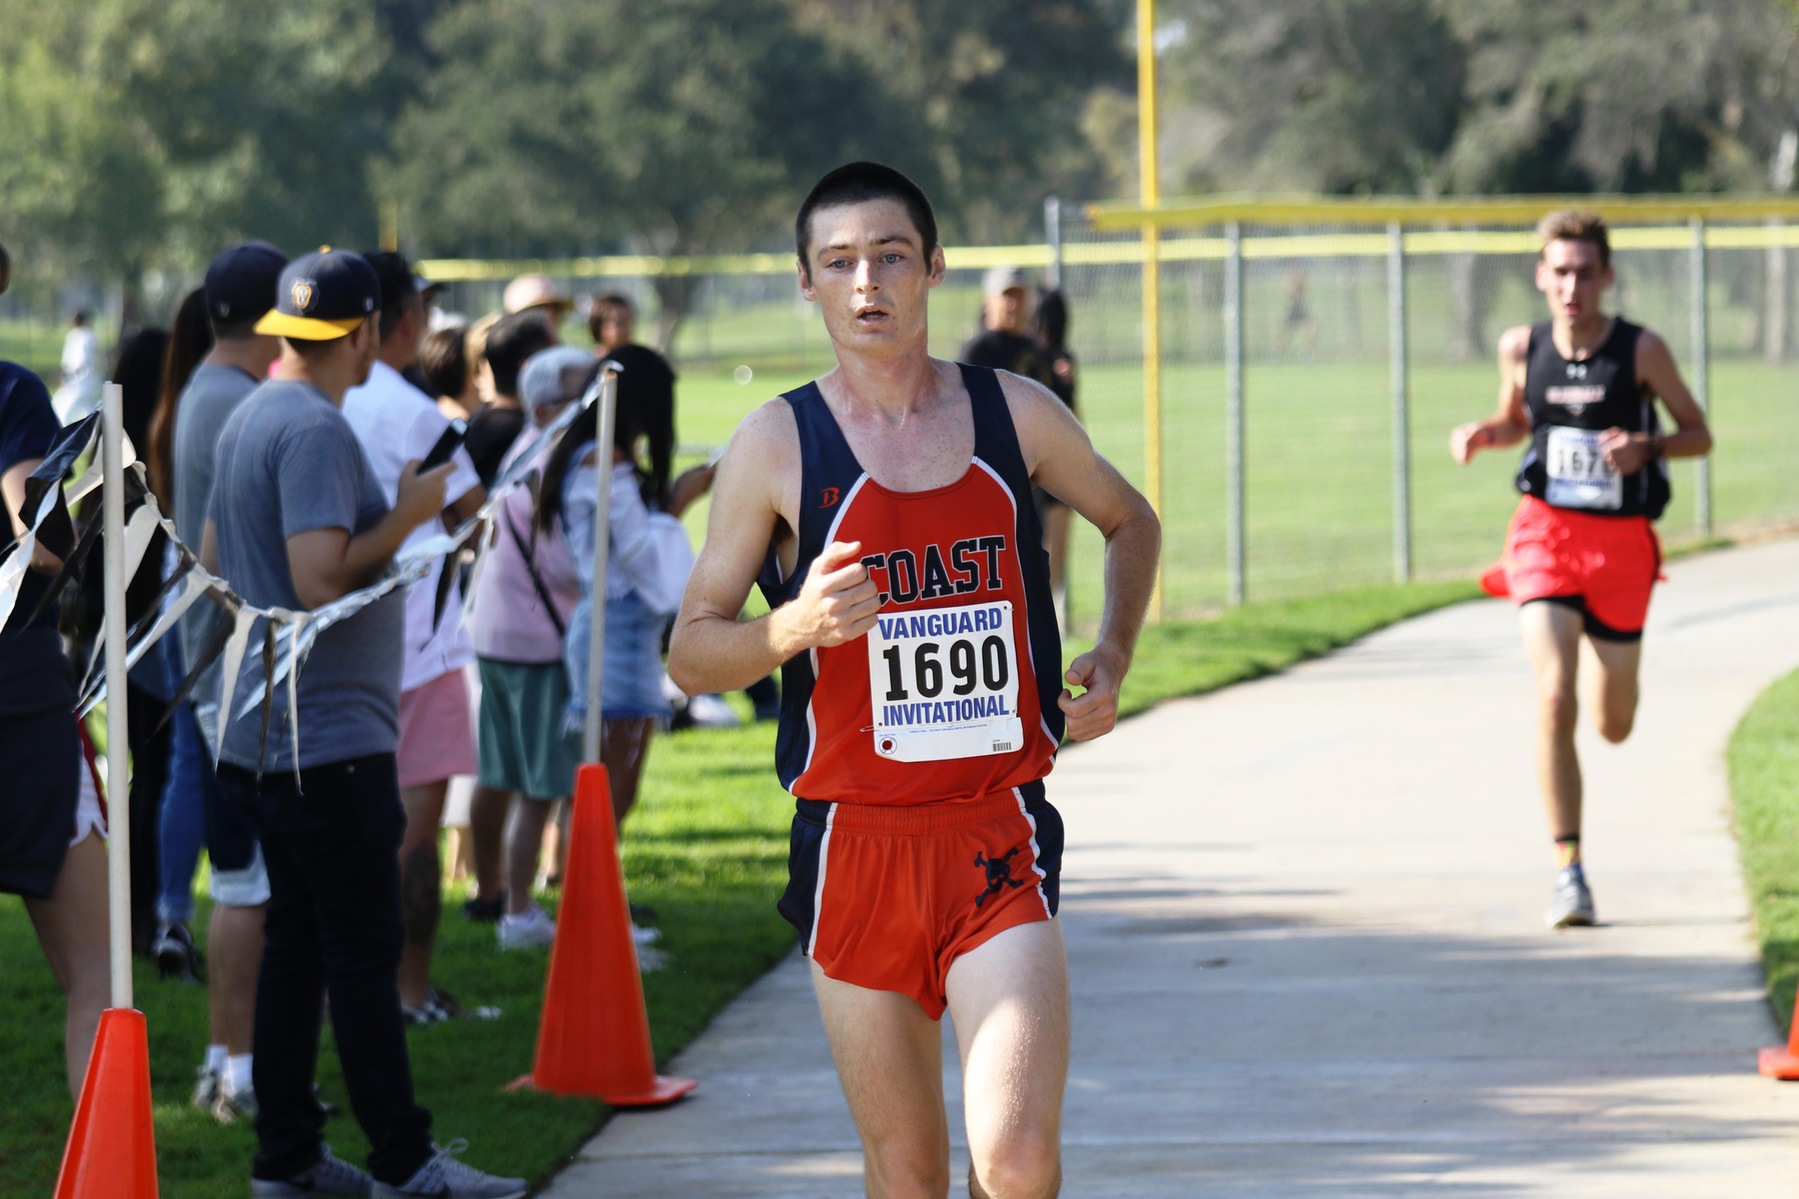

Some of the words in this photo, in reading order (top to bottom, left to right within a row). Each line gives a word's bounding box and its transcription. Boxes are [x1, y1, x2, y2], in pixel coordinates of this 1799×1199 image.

[879, 607, 1003, 640] VANGUARD
[883, 635, 1009, 701] 1690
[883, 695, 1010, 727] INVITATIONAL
